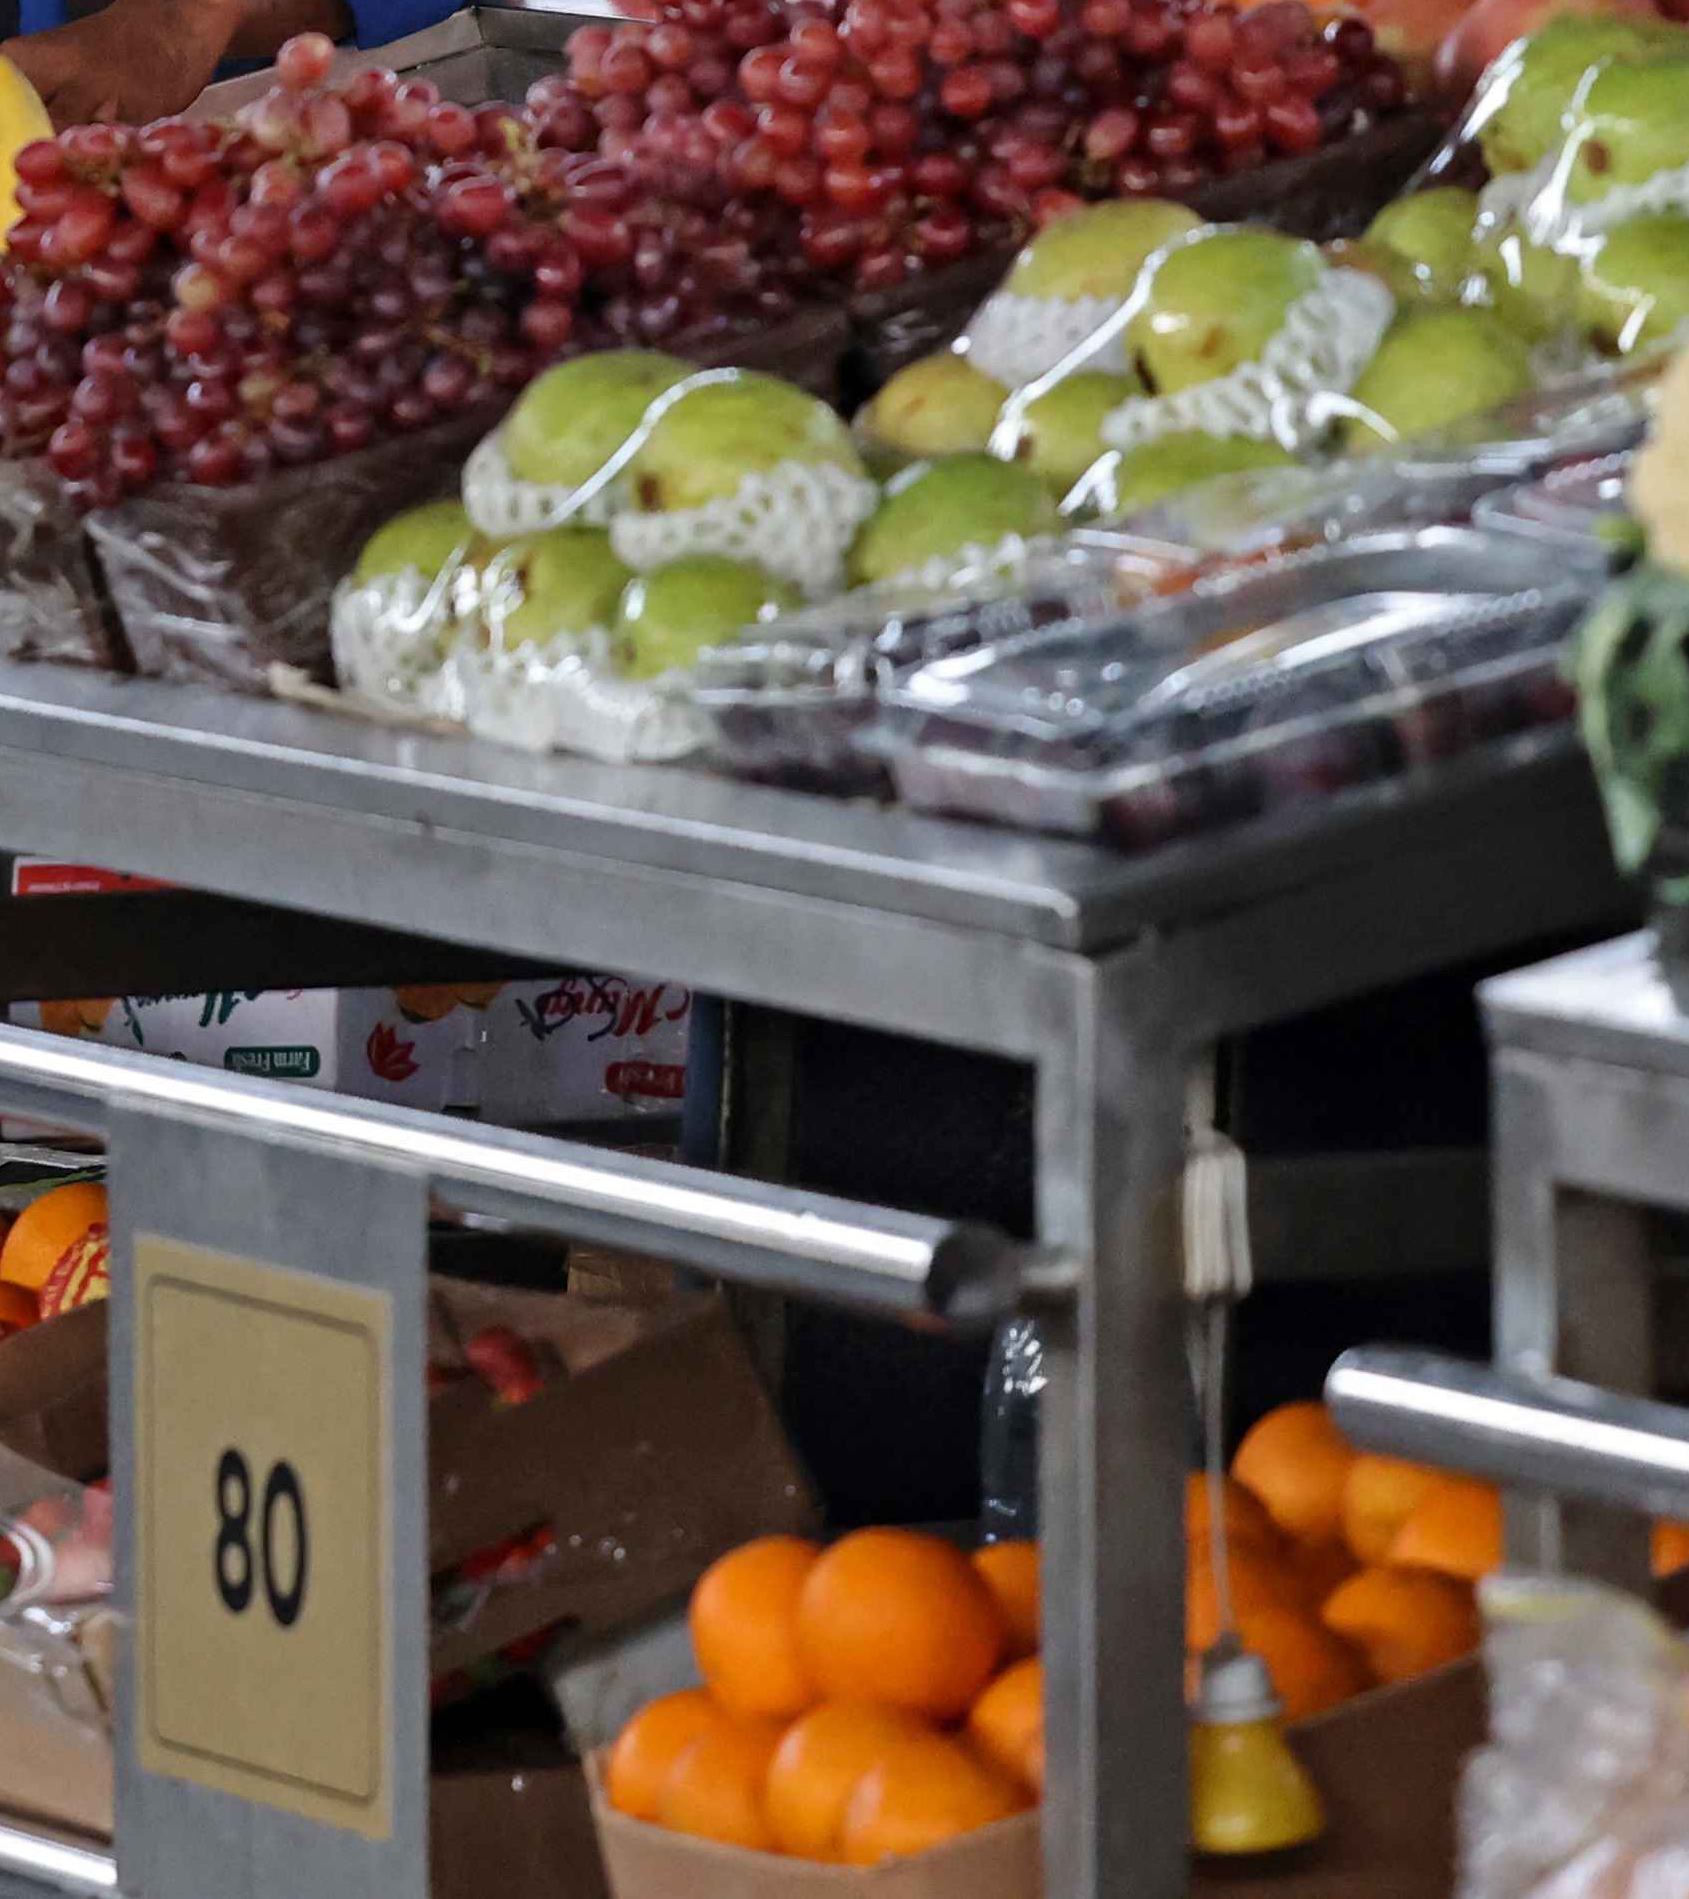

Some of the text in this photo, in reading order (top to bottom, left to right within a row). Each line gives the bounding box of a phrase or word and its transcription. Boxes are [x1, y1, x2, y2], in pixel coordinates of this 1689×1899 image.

[230, 1050, 312, 1076] Farm Fresh
[215, 1448, 309, 1628] 80
